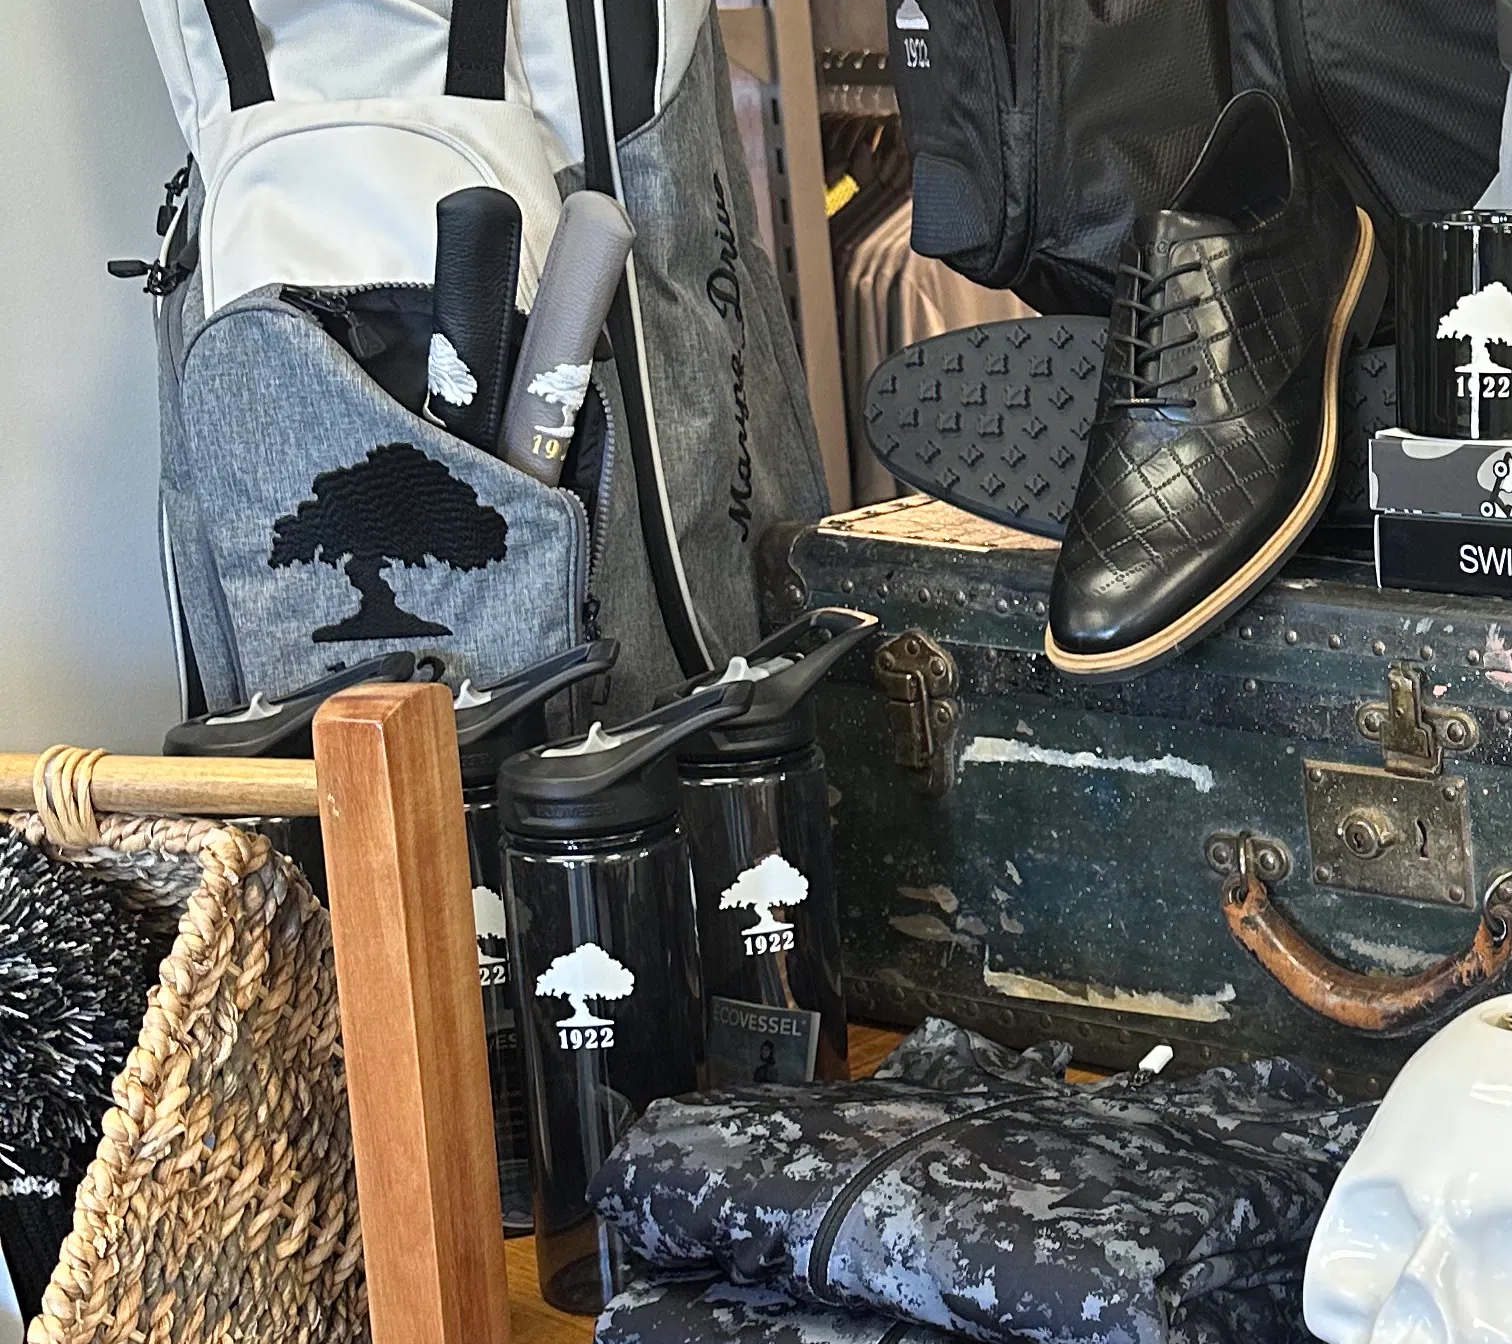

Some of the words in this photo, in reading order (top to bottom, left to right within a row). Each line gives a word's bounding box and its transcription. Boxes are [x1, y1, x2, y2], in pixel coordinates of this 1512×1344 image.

[903, 38, 931, 69] 1922
[1455, 375, 1511, 398] 1922
[743, 931, 795, 956] 1922
[480, 965, 507, 987] 22
[713, 1004, 803, 1038] ECOVESSEL
[558, 1027, 615, 1050] 1922
